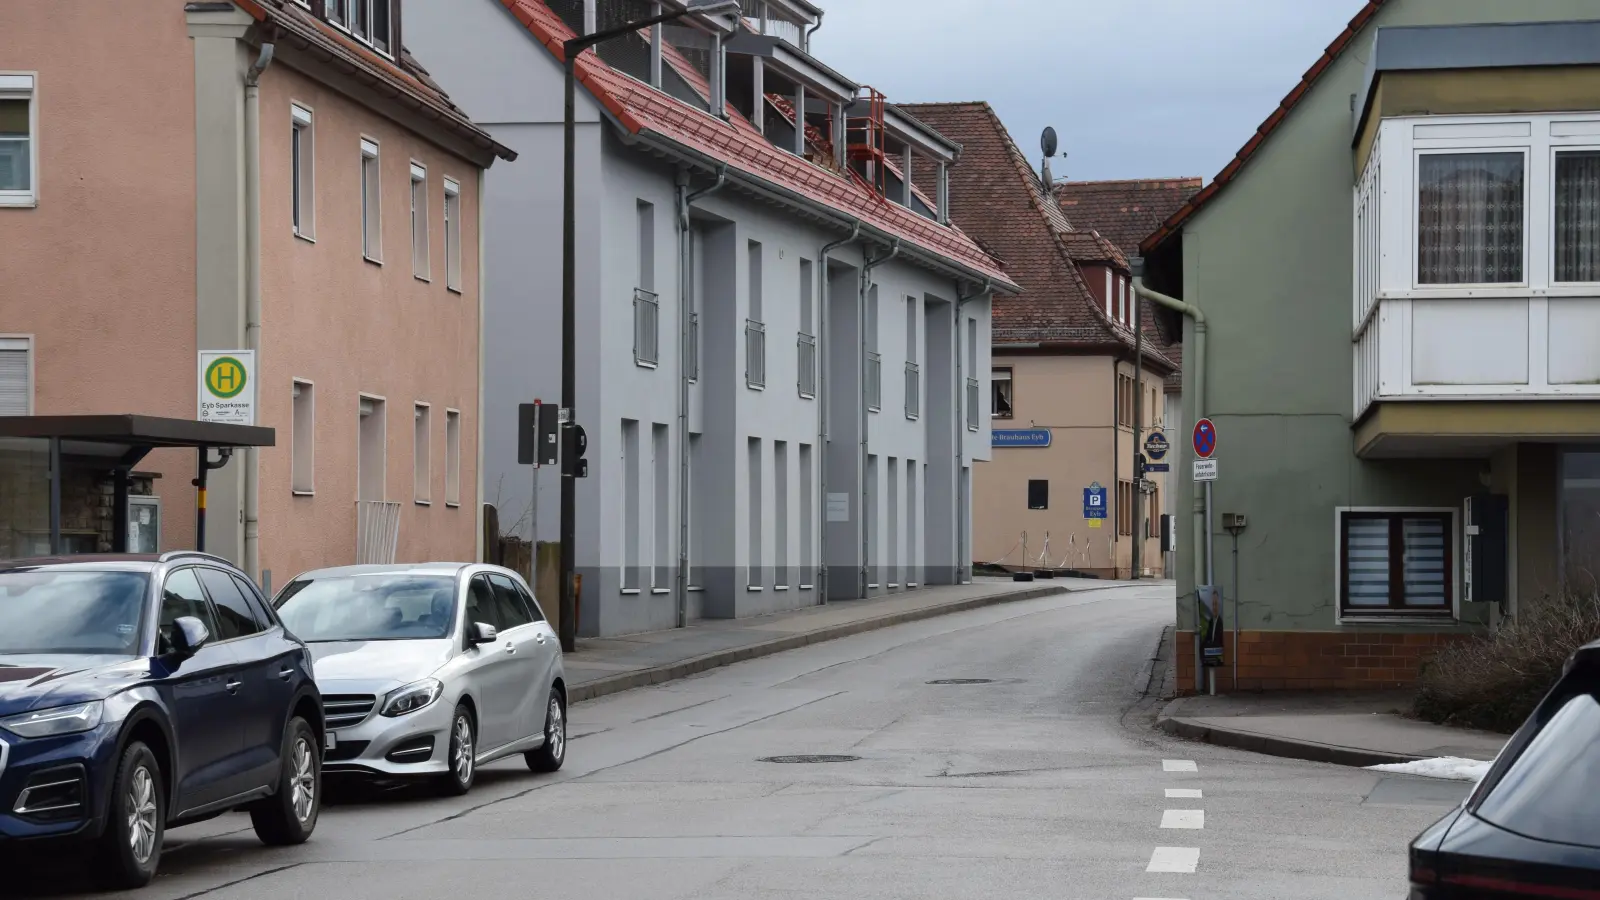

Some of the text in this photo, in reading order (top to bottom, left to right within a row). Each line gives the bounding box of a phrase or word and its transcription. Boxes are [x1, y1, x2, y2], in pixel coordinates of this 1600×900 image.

[217, 366, 235, 390] H
[202, 402, 250, 410] Eyb Sparkasse
[999, 433, 1031, 441] Brauhaus
[1031, 433, 1044, 442] Eyb
